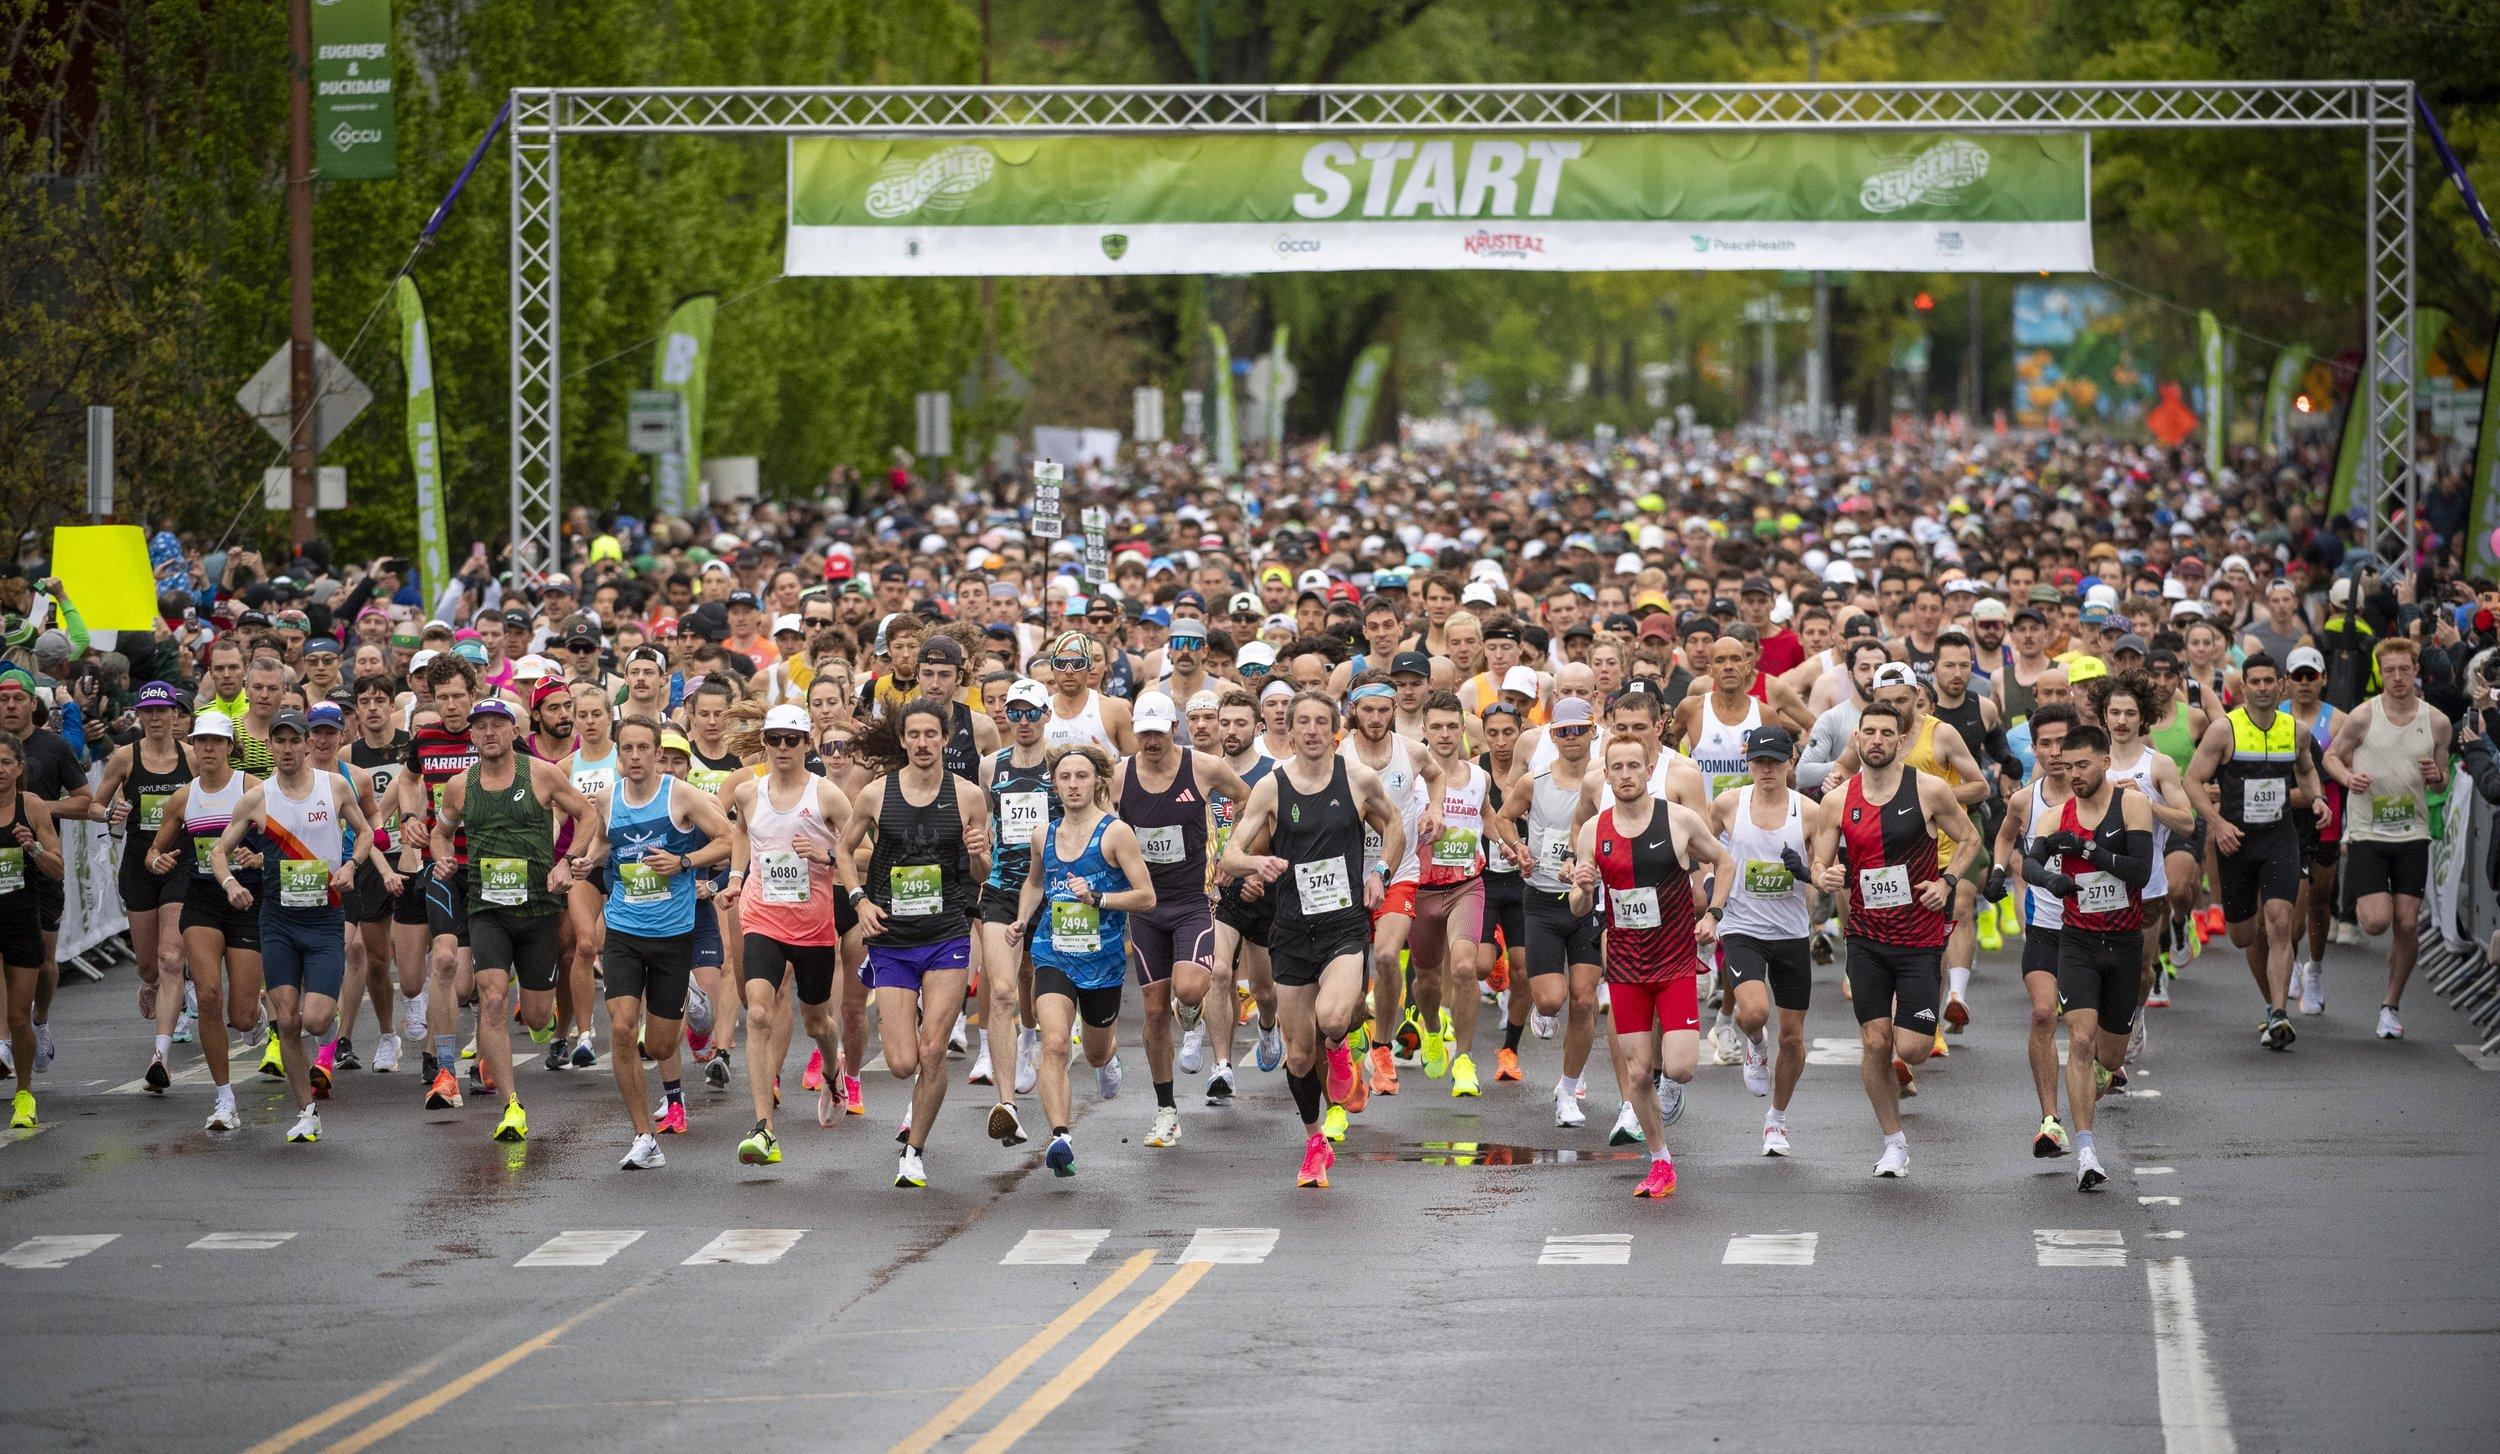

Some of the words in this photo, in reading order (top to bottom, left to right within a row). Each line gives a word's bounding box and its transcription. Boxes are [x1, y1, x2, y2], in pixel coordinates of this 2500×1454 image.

[347, 61, 360, 76] &
[318, 79, 391, 95] DUCKDASH
[338, 129, 382, 144] OCCU
[1293, 140, 1582, 219] START
[1278, 240, 1321, 252] OCCU
[1464, 233, 1545, 254] KRUSTEAZ
[1713, 237, 1796, 252] PeaceHealth
[140, 687, 168, 700] ciele
[1052, 730, 1068, 738] run
[424, 756, 481, 771] HARRIER
[138, 784, 168, 795] SKYLINE
[2254, 791, 2276, 802] 6331
[151, 807, 163, 819] 28
[308, 811, 328, 822] DWR
[1011, 807, 1037, 819] 5716
[1446, 805, 1478, 817] LIZARD
[2382, 806, 2406, 818] 2924
[1147, 840, 1171, 852] 6317
[1365, 836, 1383, 847] 821
[1443, 842, 1468, 854] 3029
[1552, 843, 1568, 854] 57
[490, 872, 517, 884] 2489
[770, 867, 798, 878] 6080
[291, 874, 318, 886] 2497
[631, 877, 656, 891] 2411
[1309, 873, 1335, 889] 5747
[1756, 875, 1785, 887] 2477
[902, 880, 931, 893] 2495
[1871, 881, 1898, 895] 5945
[2089, 884, 2116, 899] 5719
[1621, 903, 1647, 915] 5740
[1061, 917, 1088, 929] 2494
